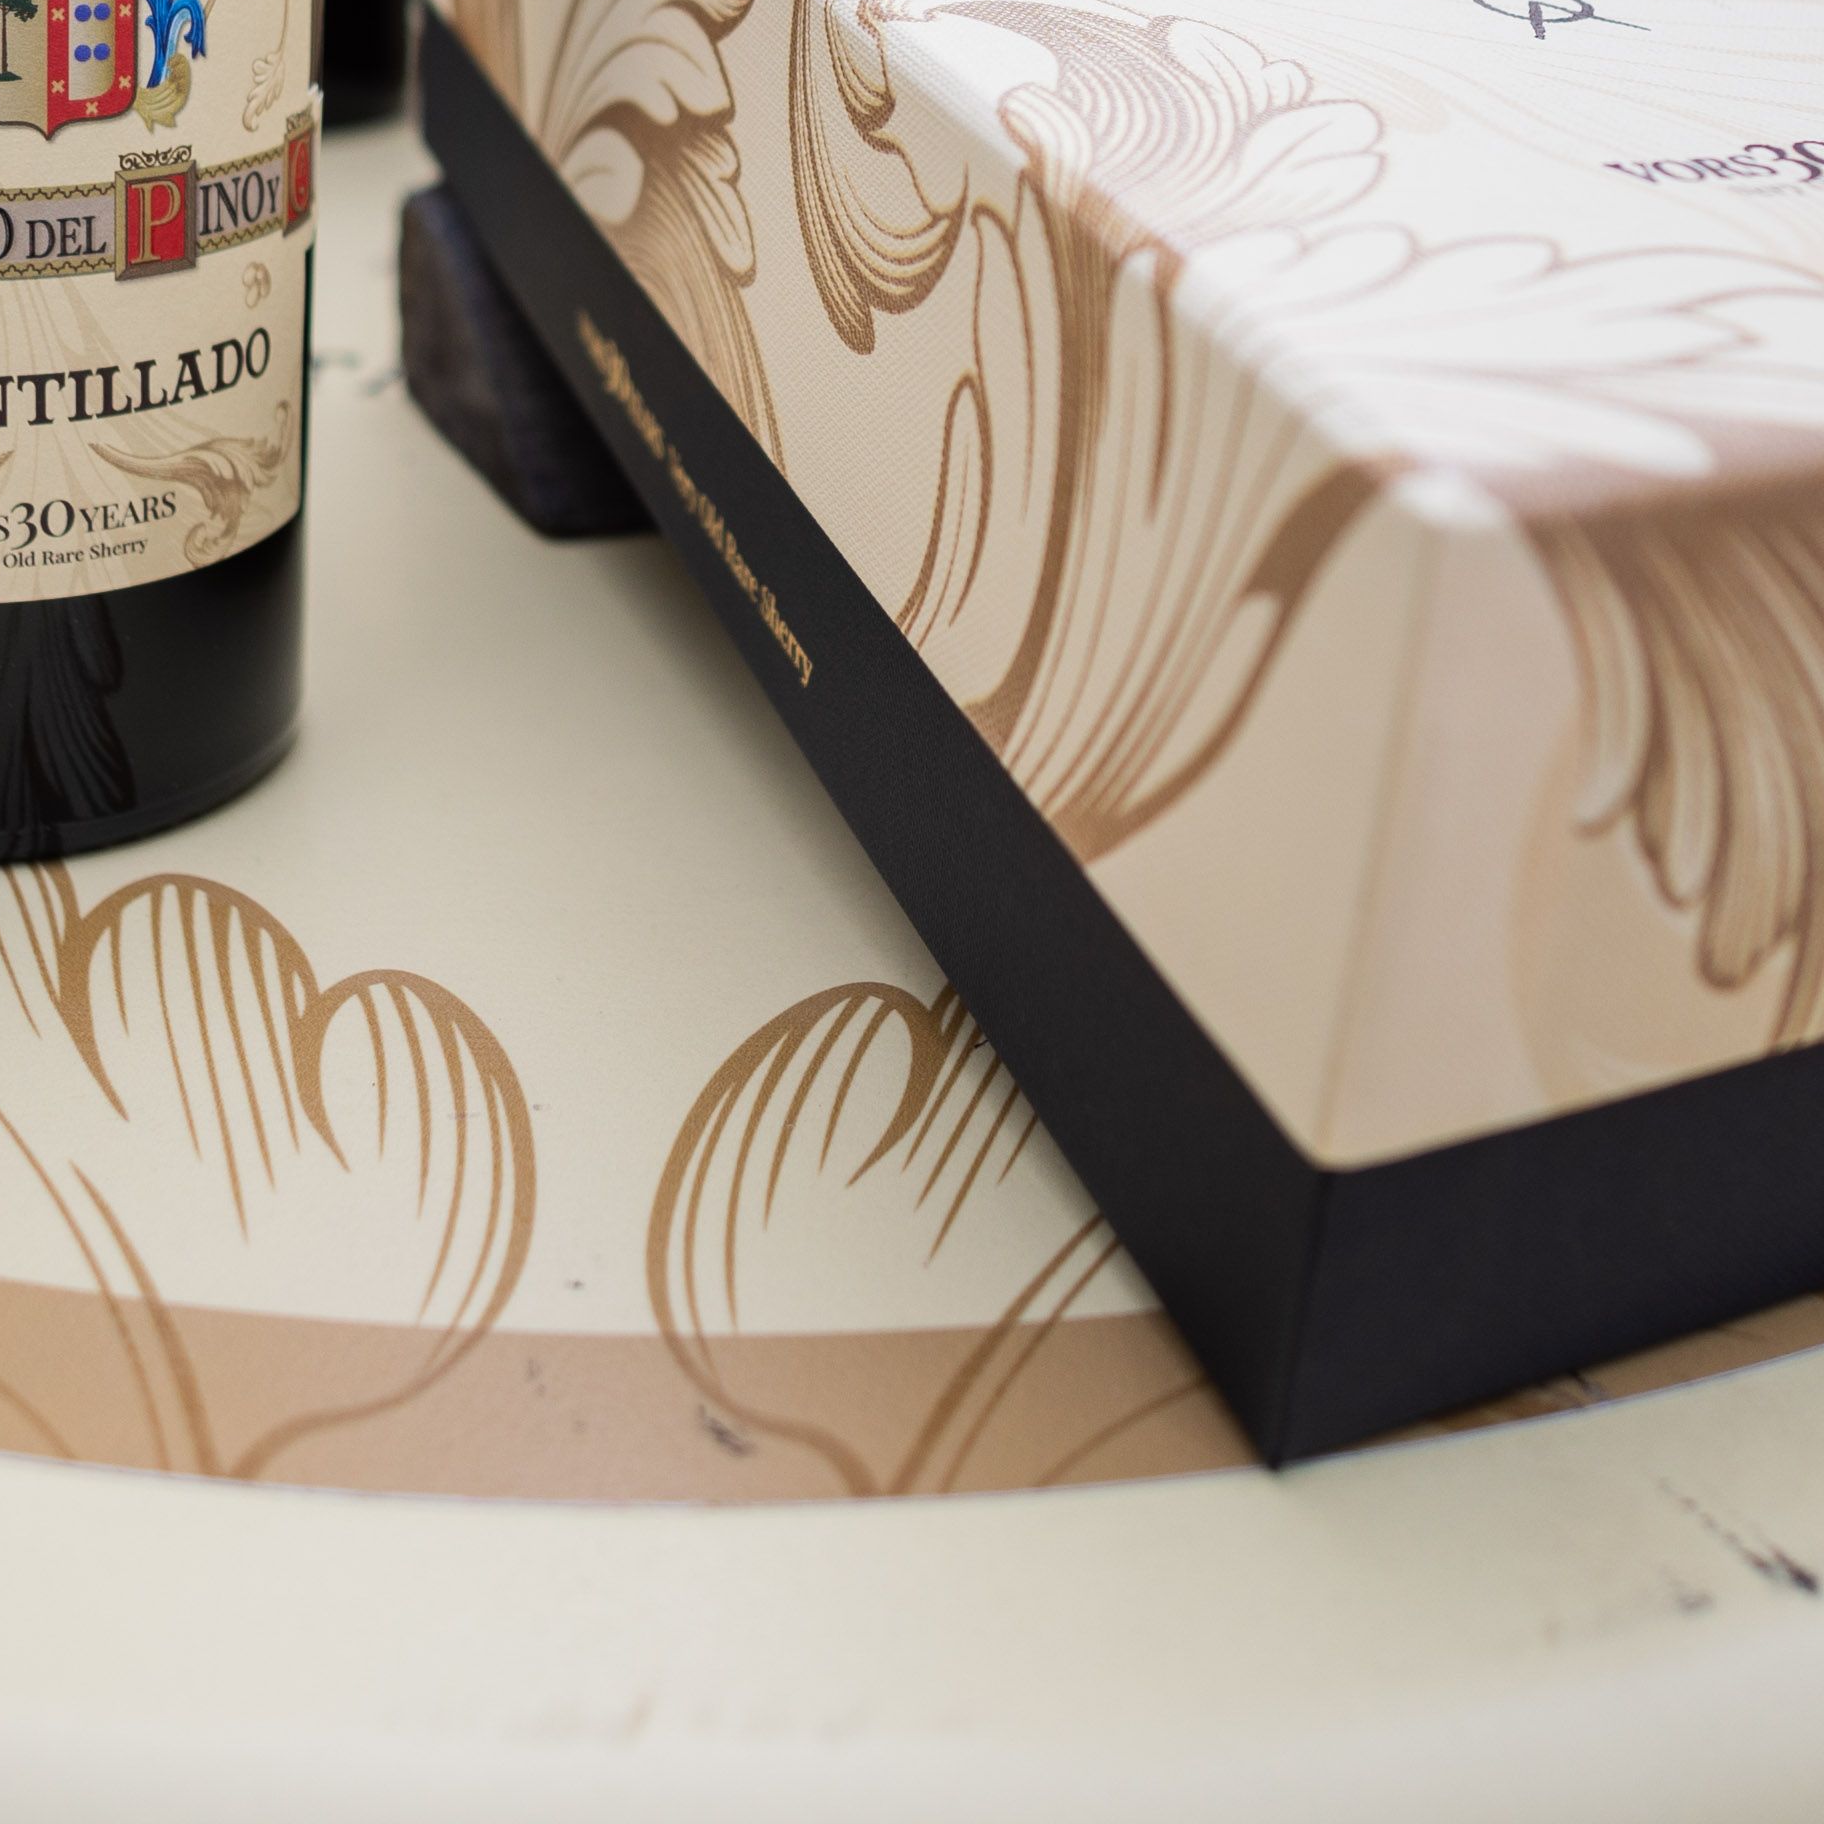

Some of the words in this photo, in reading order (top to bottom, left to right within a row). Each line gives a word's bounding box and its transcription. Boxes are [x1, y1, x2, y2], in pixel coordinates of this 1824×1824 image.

[25, 215, 108, 259] DEL
[130, 169, 265, 265] PINO
[78, 490, 178, 534] YEARS
[2, 549, 36, 569] Old
[42, 548, 86, 567] Rare
[88, 538, 149, 561] Sherry
